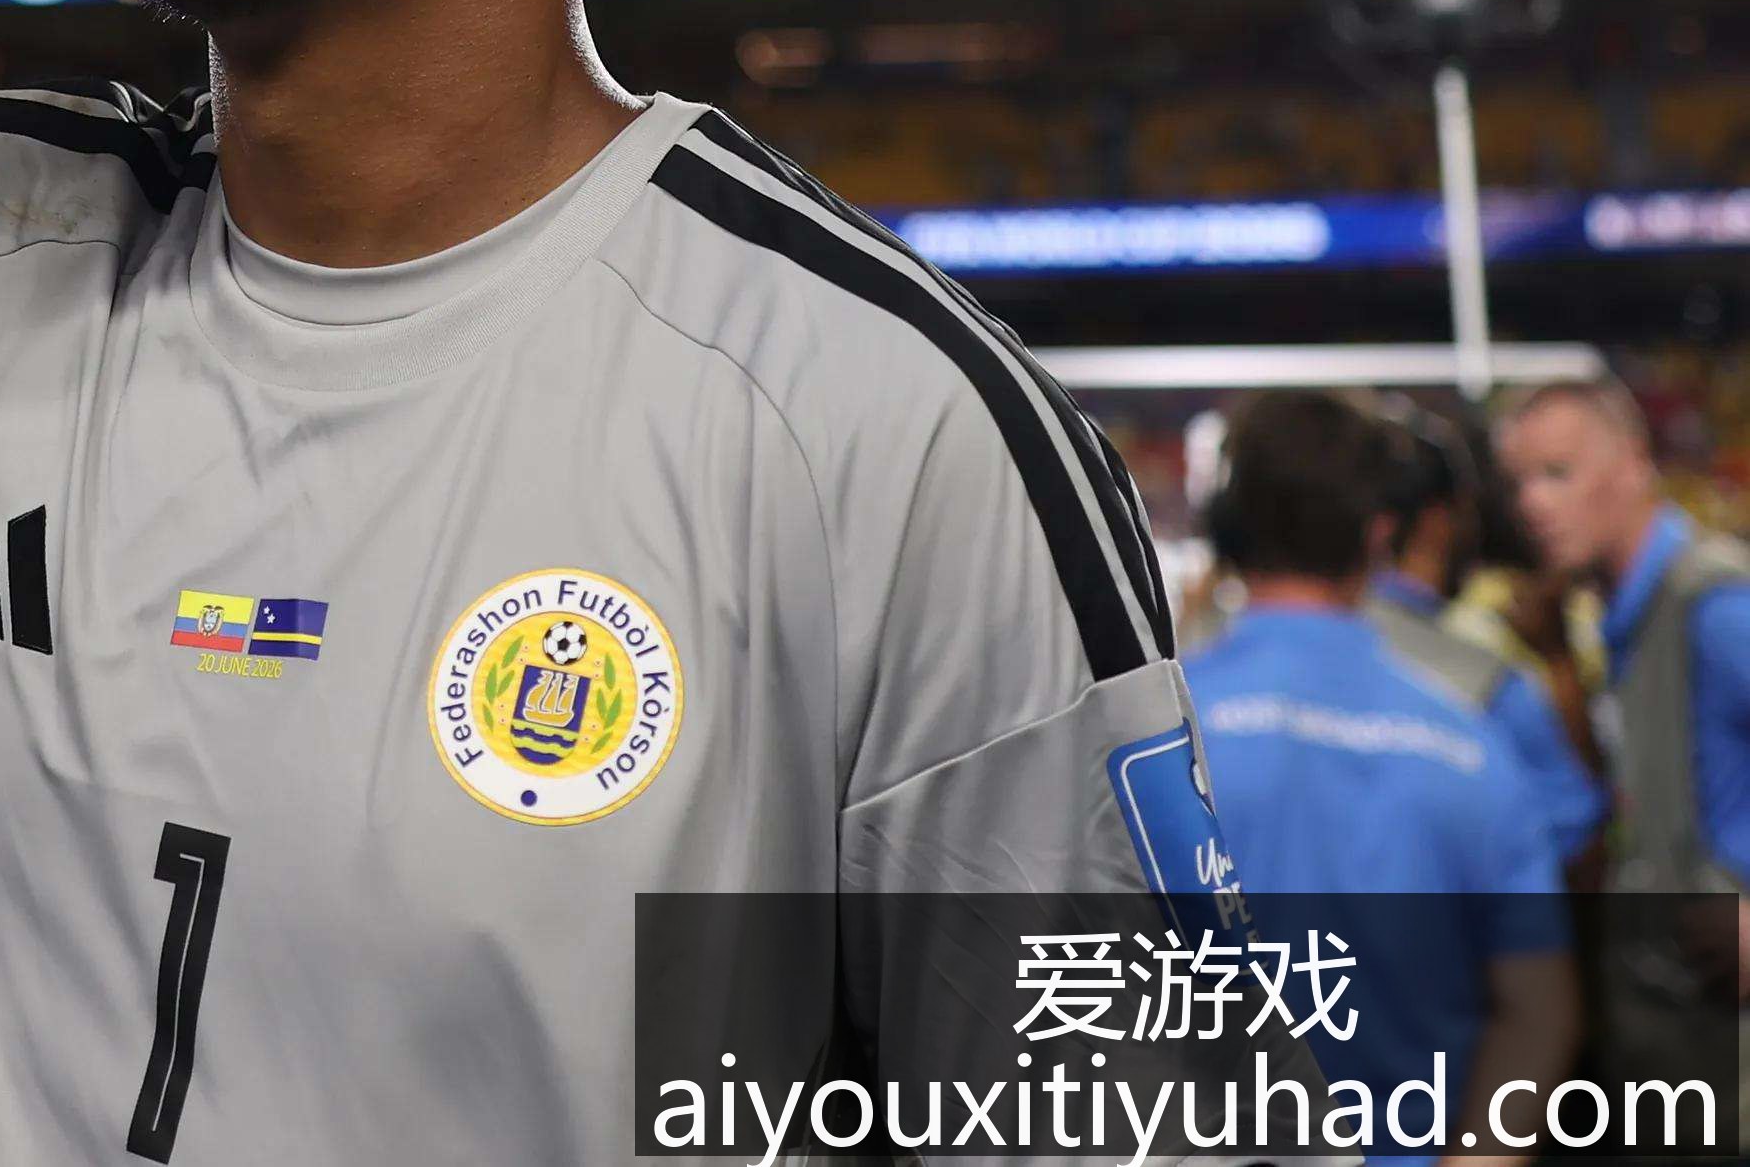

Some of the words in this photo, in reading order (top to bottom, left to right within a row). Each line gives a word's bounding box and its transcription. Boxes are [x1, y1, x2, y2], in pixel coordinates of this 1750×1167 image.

[196, 653, 216, 673] 20
[215, 655, 252, 677] JUNE
[251, 658, 283, 679] 2026
[440, 588, 543, 769] Federashon
[556, 579, 660, 658] Futbòl
[595, 670, 671, 791] Kòrsou
[126, 820, 232, 1165] 1
